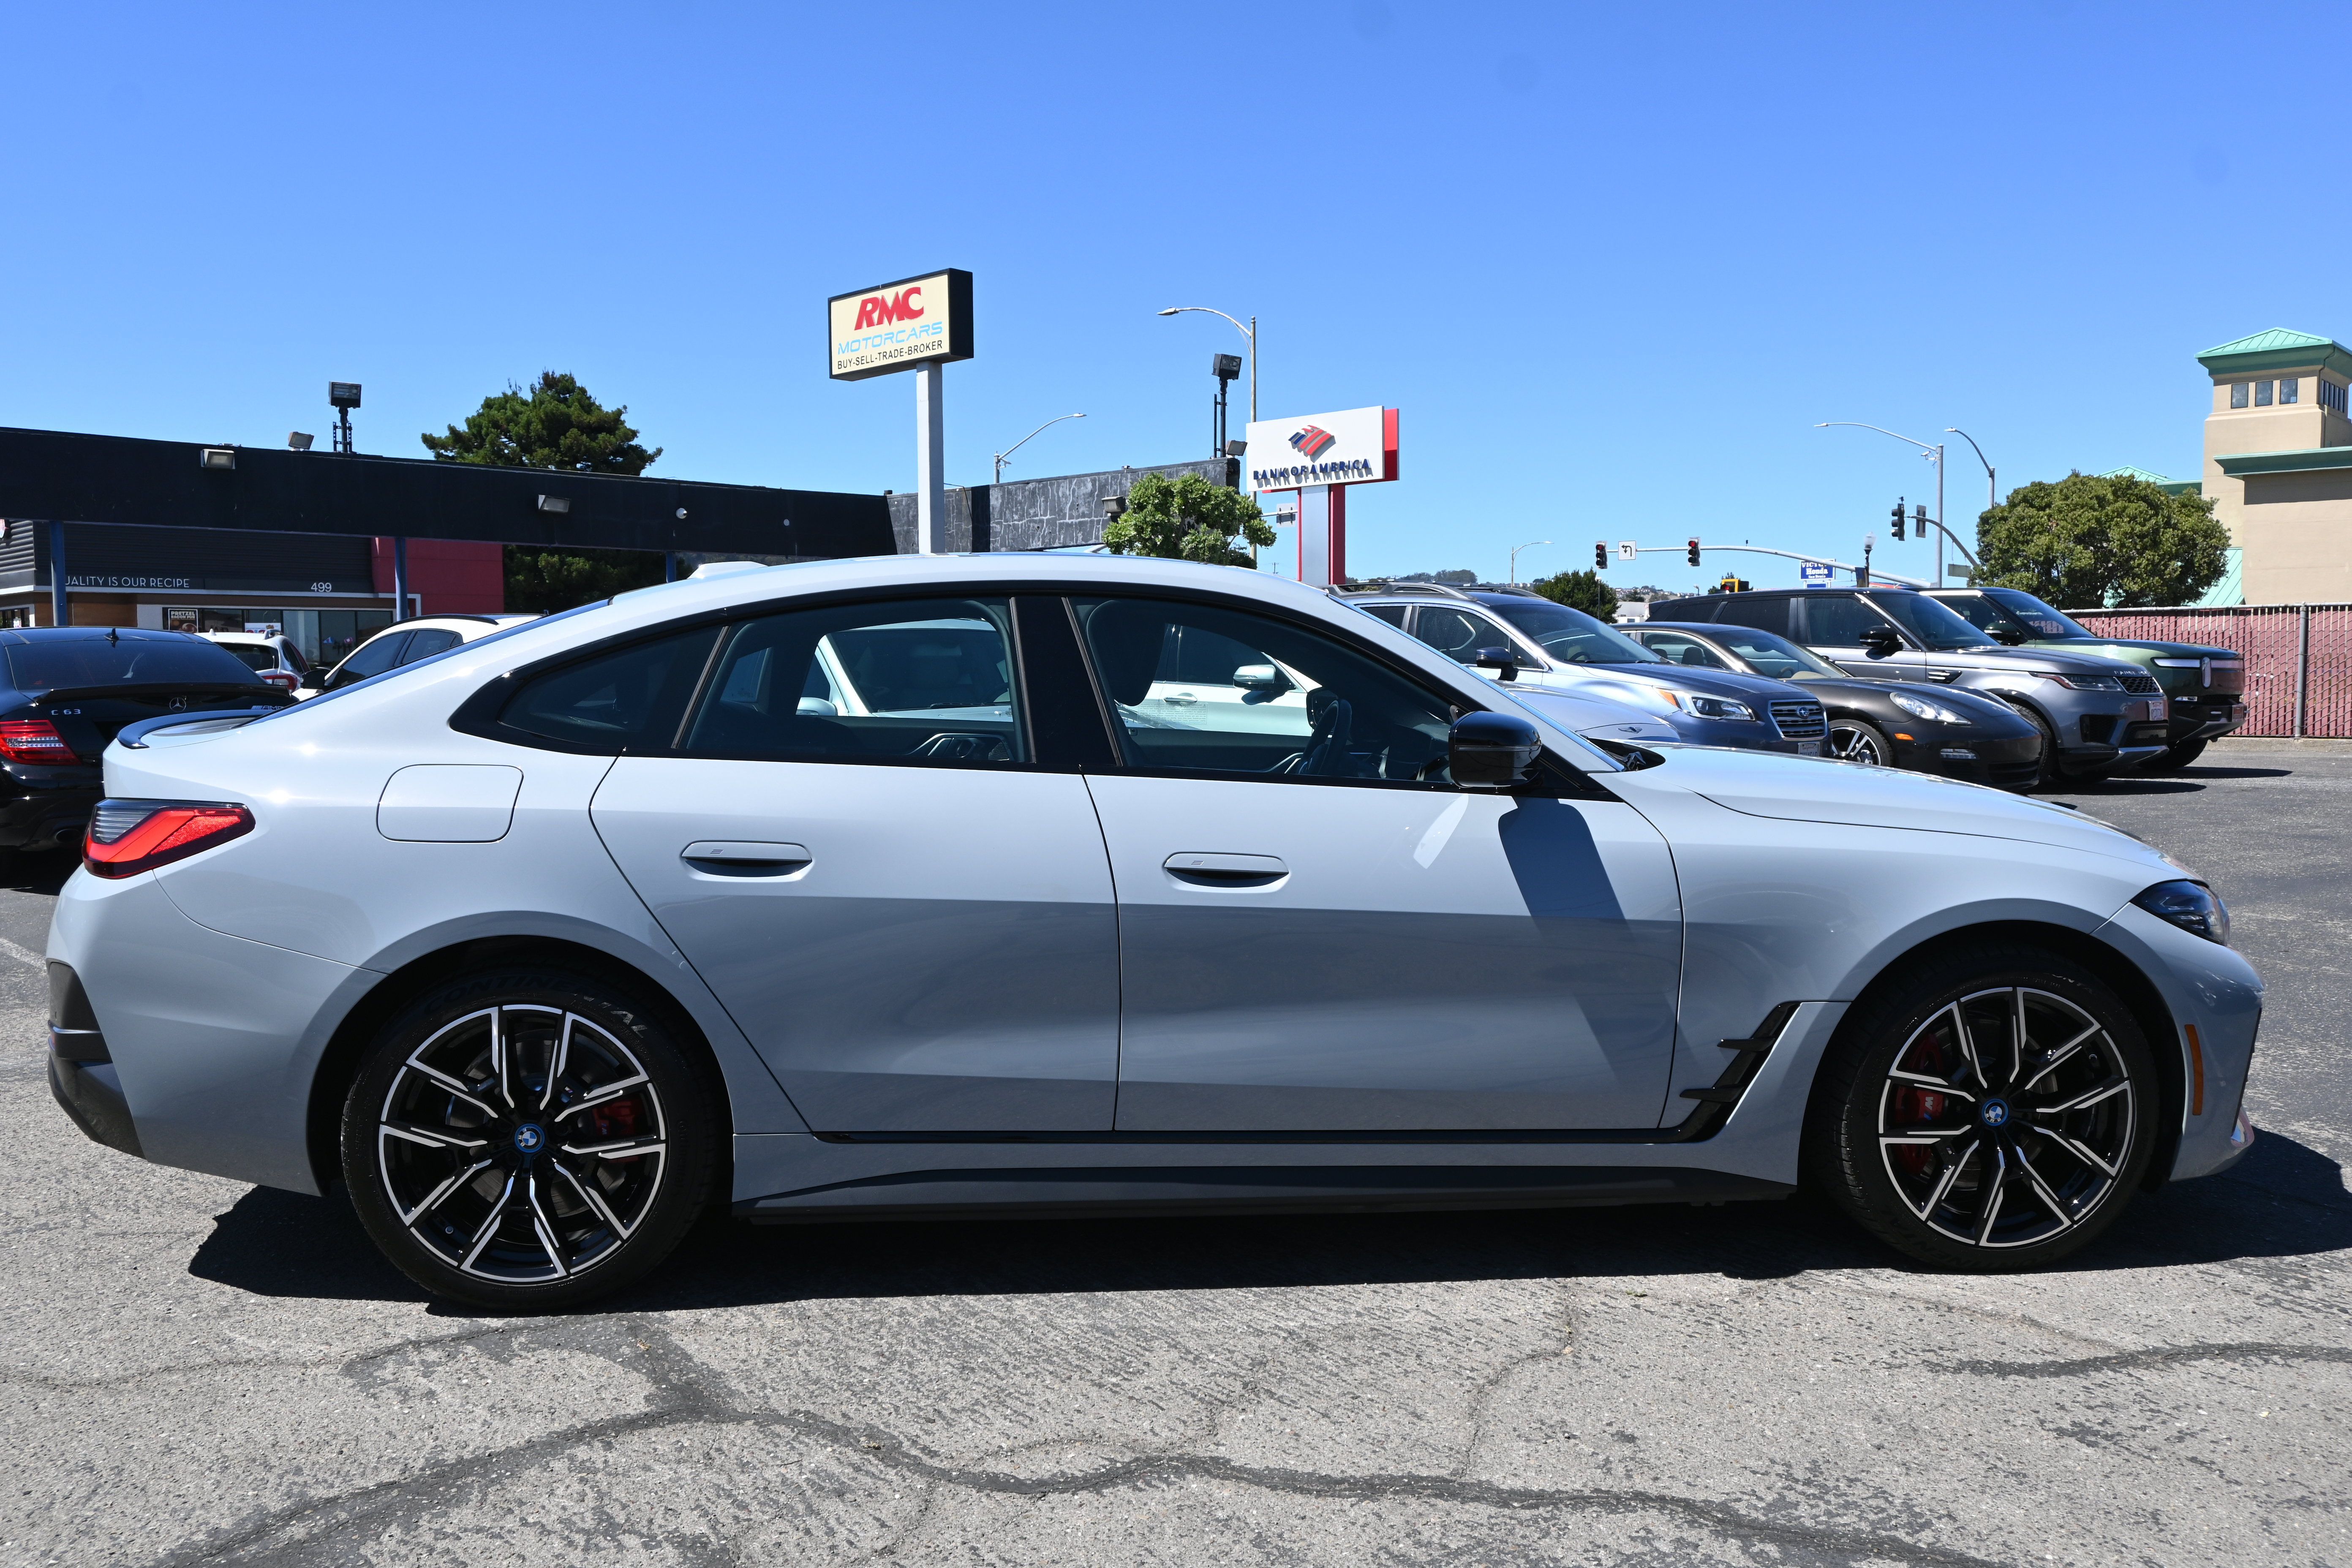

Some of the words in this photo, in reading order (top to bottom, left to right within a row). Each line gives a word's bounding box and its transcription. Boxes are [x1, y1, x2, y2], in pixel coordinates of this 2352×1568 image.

[854, 286, 924, 331] RMC
[838, 321, 943, 355] MOTORCARS
[837, 340, 943, 370] BUY-SELL-TRADE-BROKER
[1253, 467, 1288, 480] BANK
[1290, 465, 1308, 476] OF
[1310, 458, 1369, 474] AMERICA
[65, 576, 104, 586] UALITY
[109, 577, 118, 586] IS
[121, 577, 146, 587] OUR
[150, 578, 190, 588] RECIPE
[310, 582, 332, 592] 499
